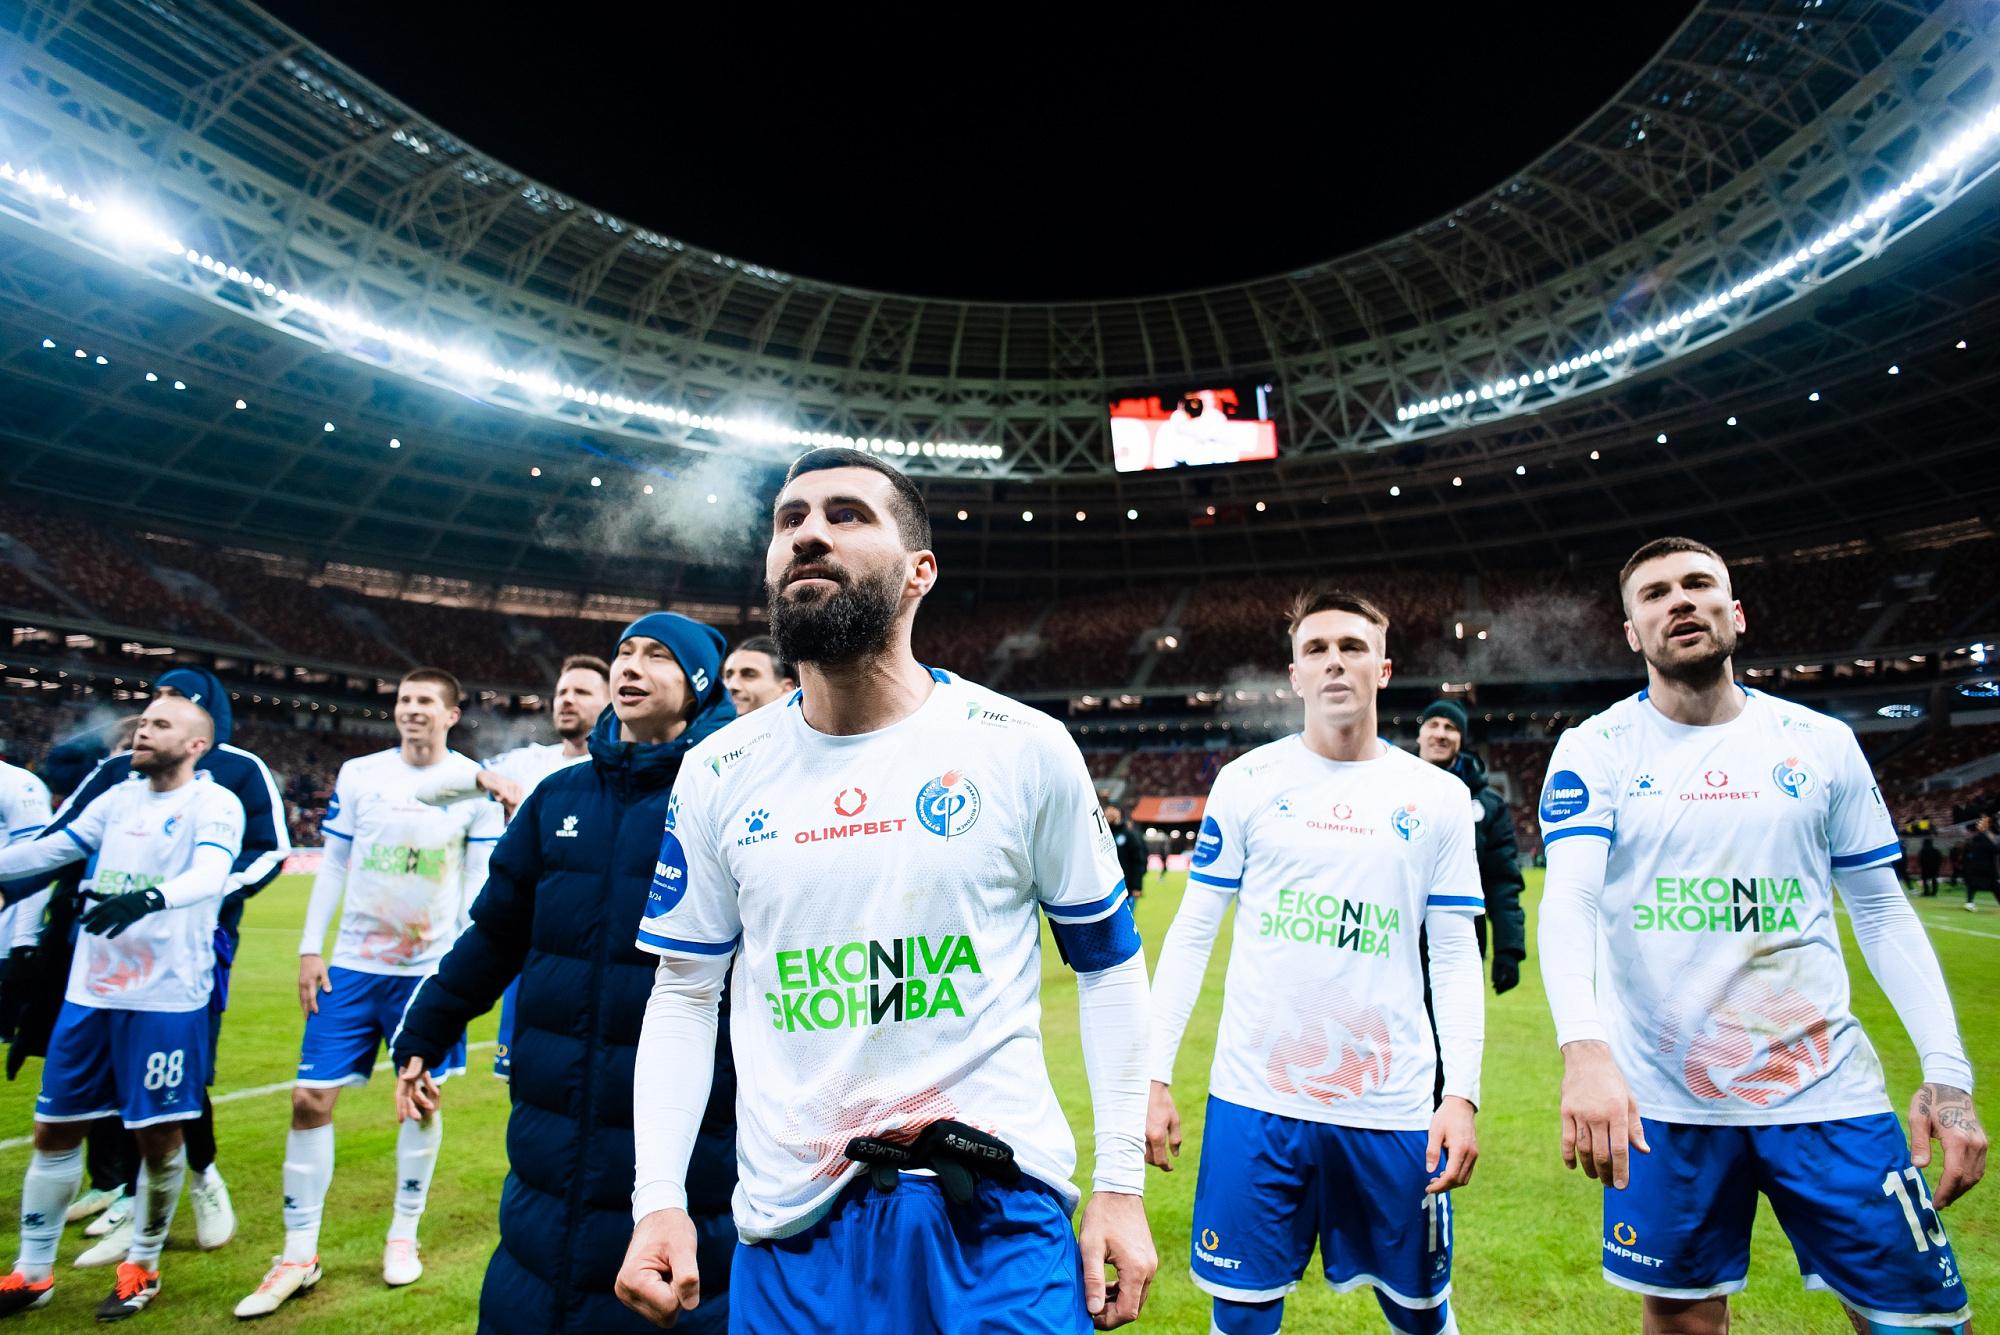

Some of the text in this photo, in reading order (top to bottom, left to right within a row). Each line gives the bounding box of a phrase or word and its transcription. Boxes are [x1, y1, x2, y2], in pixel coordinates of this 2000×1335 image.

[1679, 790, 1761, 801] OLIMPBET
[737, 830, 779, 847] KELME
[794, 818, 907, 844] OLIMPBET
[1306, 820, 1376, 836] OLIMPBET
[648, 890, 662, 901] 3/24
[1656, 877, 1806, 904] EKONIVA
[1277, 888, 1401, 934] EKONIVA
[1632, 904, 1801, 933] ЭКОНИВА
[1259, 911, 1390, 959] ЭКОНИВА
[775, 934, 982, 990] EKONIVA
[765, 977, 966, 1033] ЭКОНИВА
[143, 1049, 185, 1091] 88
[955, 1136, 1009, 1161] KELME
[1421, 1192, 1449, 1253] 11
[1881, 1165, 1947, 1253] 13
[1602, 1237, 1664, 1268] LIMPBET
